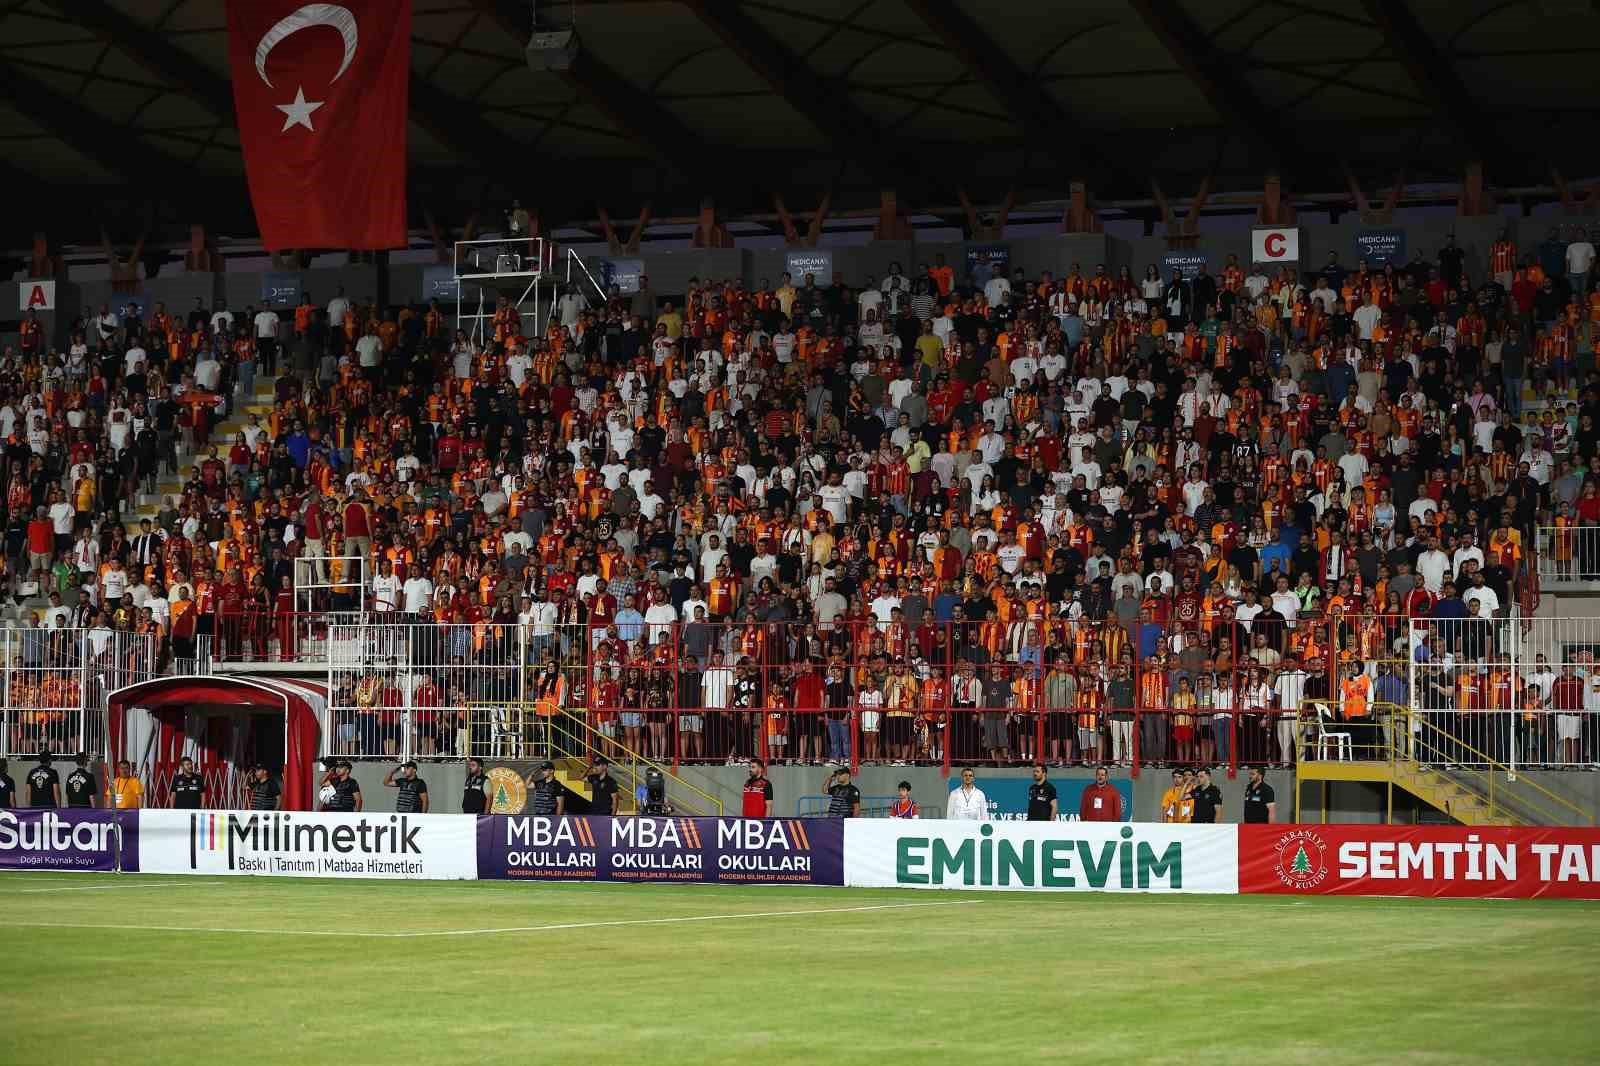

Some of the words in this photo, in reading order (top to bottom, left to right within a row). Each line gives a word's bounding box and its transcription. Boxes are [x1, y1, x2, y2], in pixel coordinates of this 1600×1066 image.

[1264, 233, 1287, 257] C
[1165, 257, 1201, 265] MEDICANA
[28, 285, 47, 306] A
[0, 811, 122, 851] Sultan
[228, 813, 422, 866] Milimetrik
[507, 816, 577, 847] MBA
[611, 817, 682, 848] MBA
[718, 819, 790, 850] MBA
[20, 856, 43, 865] Doğal
[45, 857, 73, 865] Kaynak
[75, 857, 95, 865] Suyu
[238, 856, 267, 871] Baskı
[275, 857, 315, 872] Tanıtım
[324, 858, 364, 873] Matbaa
[367, 859, 423, 874] Hizmetleri
[507, 851, 596, 867] OKULLARI
[611, 853, 702, 869] OKULLARI
[718, 854, 811, 871] OKULLARI
[897, 823, 1182, 889] EMİNEVİM
[1338, 834, 1517, 881] SEMTİN
